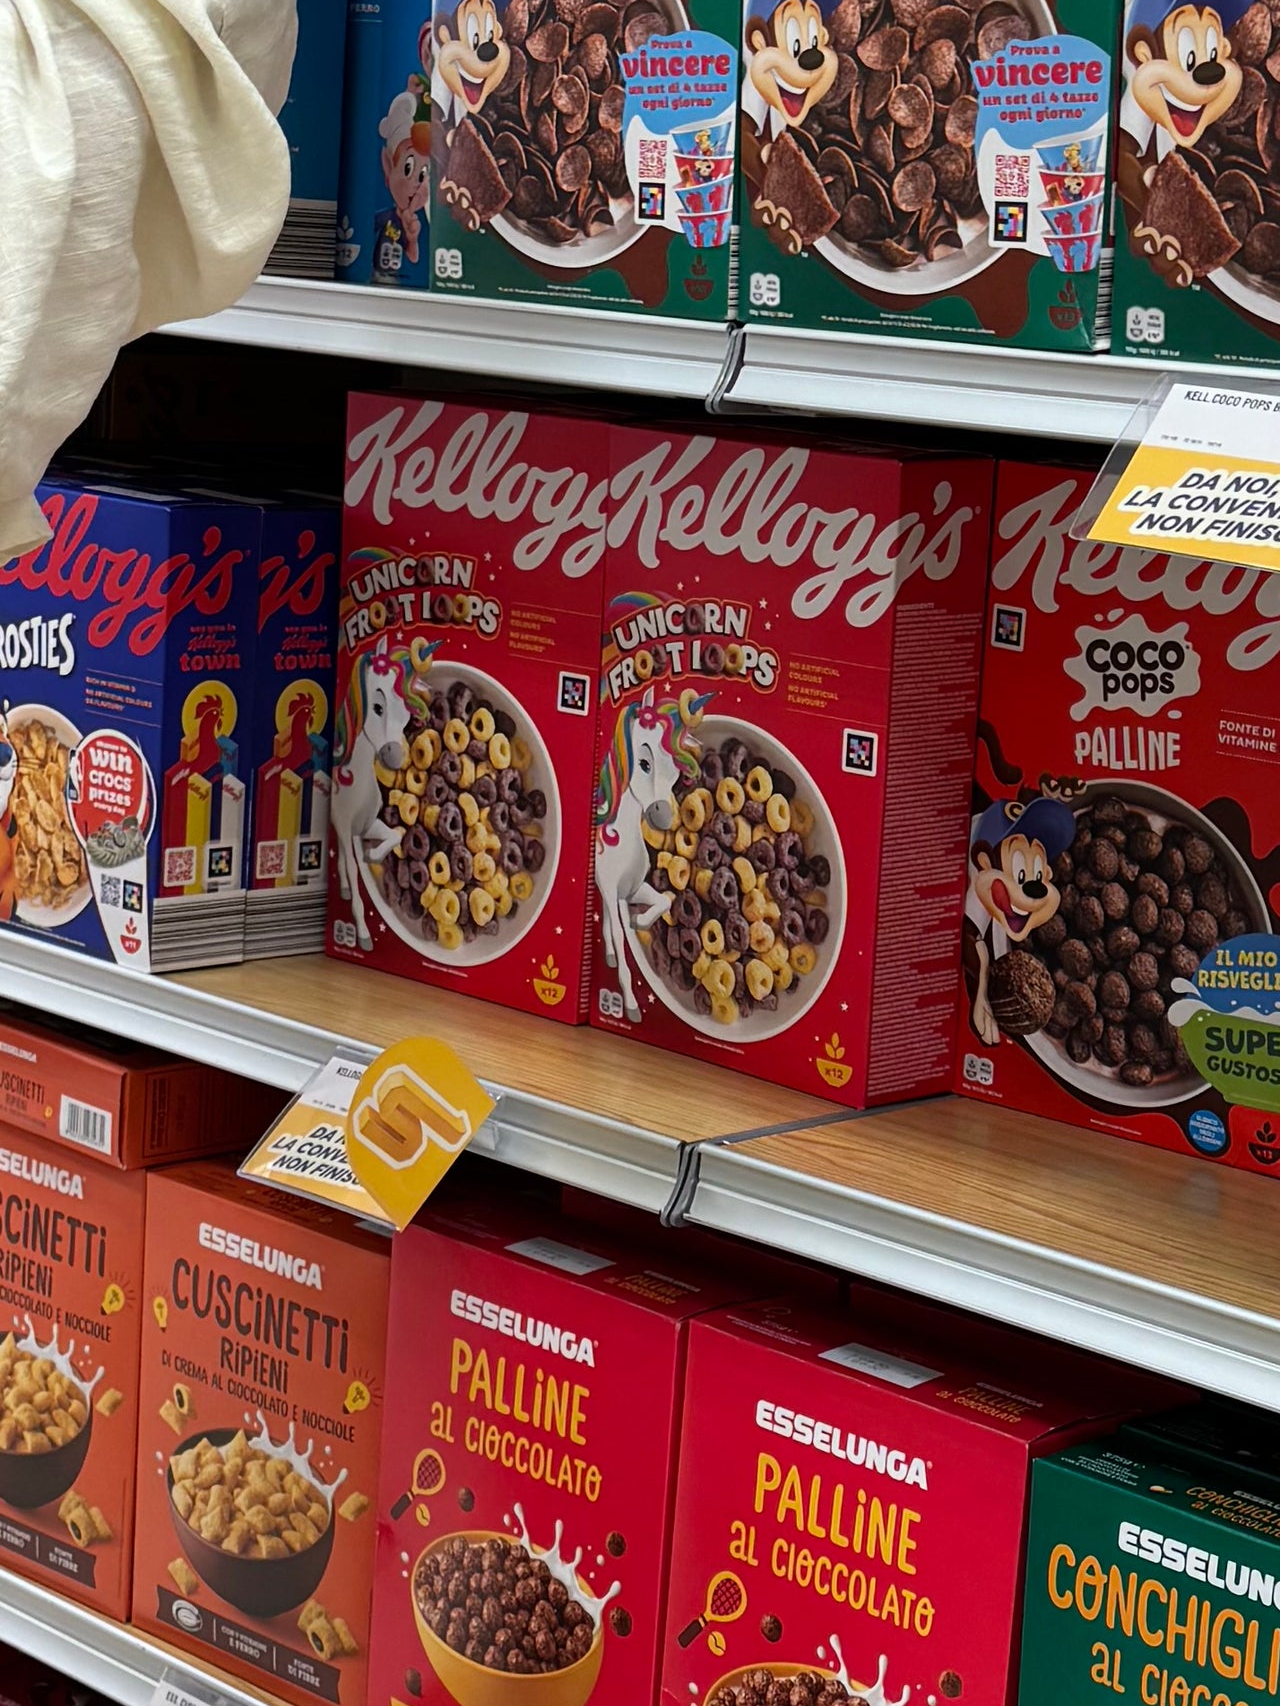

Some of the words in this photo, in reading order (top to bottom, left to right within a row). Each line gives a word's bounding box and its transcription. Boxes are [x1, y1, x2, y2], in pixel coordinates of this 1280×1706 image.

[622, 52, 732, 80] vincere
[975, 56, 1103, 87] vincere
[1179, 473, 1221, 490] DA
[1226, 476, 1279, 497] NOI,
[608, 436, 974, 629] Kellogg's
[1136, 514, 1204, 533] NON
[351, 553, 473, 602] UNICORN
[179, 653, 241, 672] town
[1085, 638, 1186, 673] COCO
[90, 747, 133, 774] win
[1074, 728, 1181, 770] PALLINE
[89, 770, 131, 792] crocs
[88, 787, 131, 807] prizes
[1214, 949, 1231, 968] IL
[1236, 947, 1278, 968] MIO
[198, 1222, 323, 1290] ESSELUNGA
[450, 1289, 599, 1368] ESSELUNGA
[755, 1399, 931, 1490] ESSELUNGA
